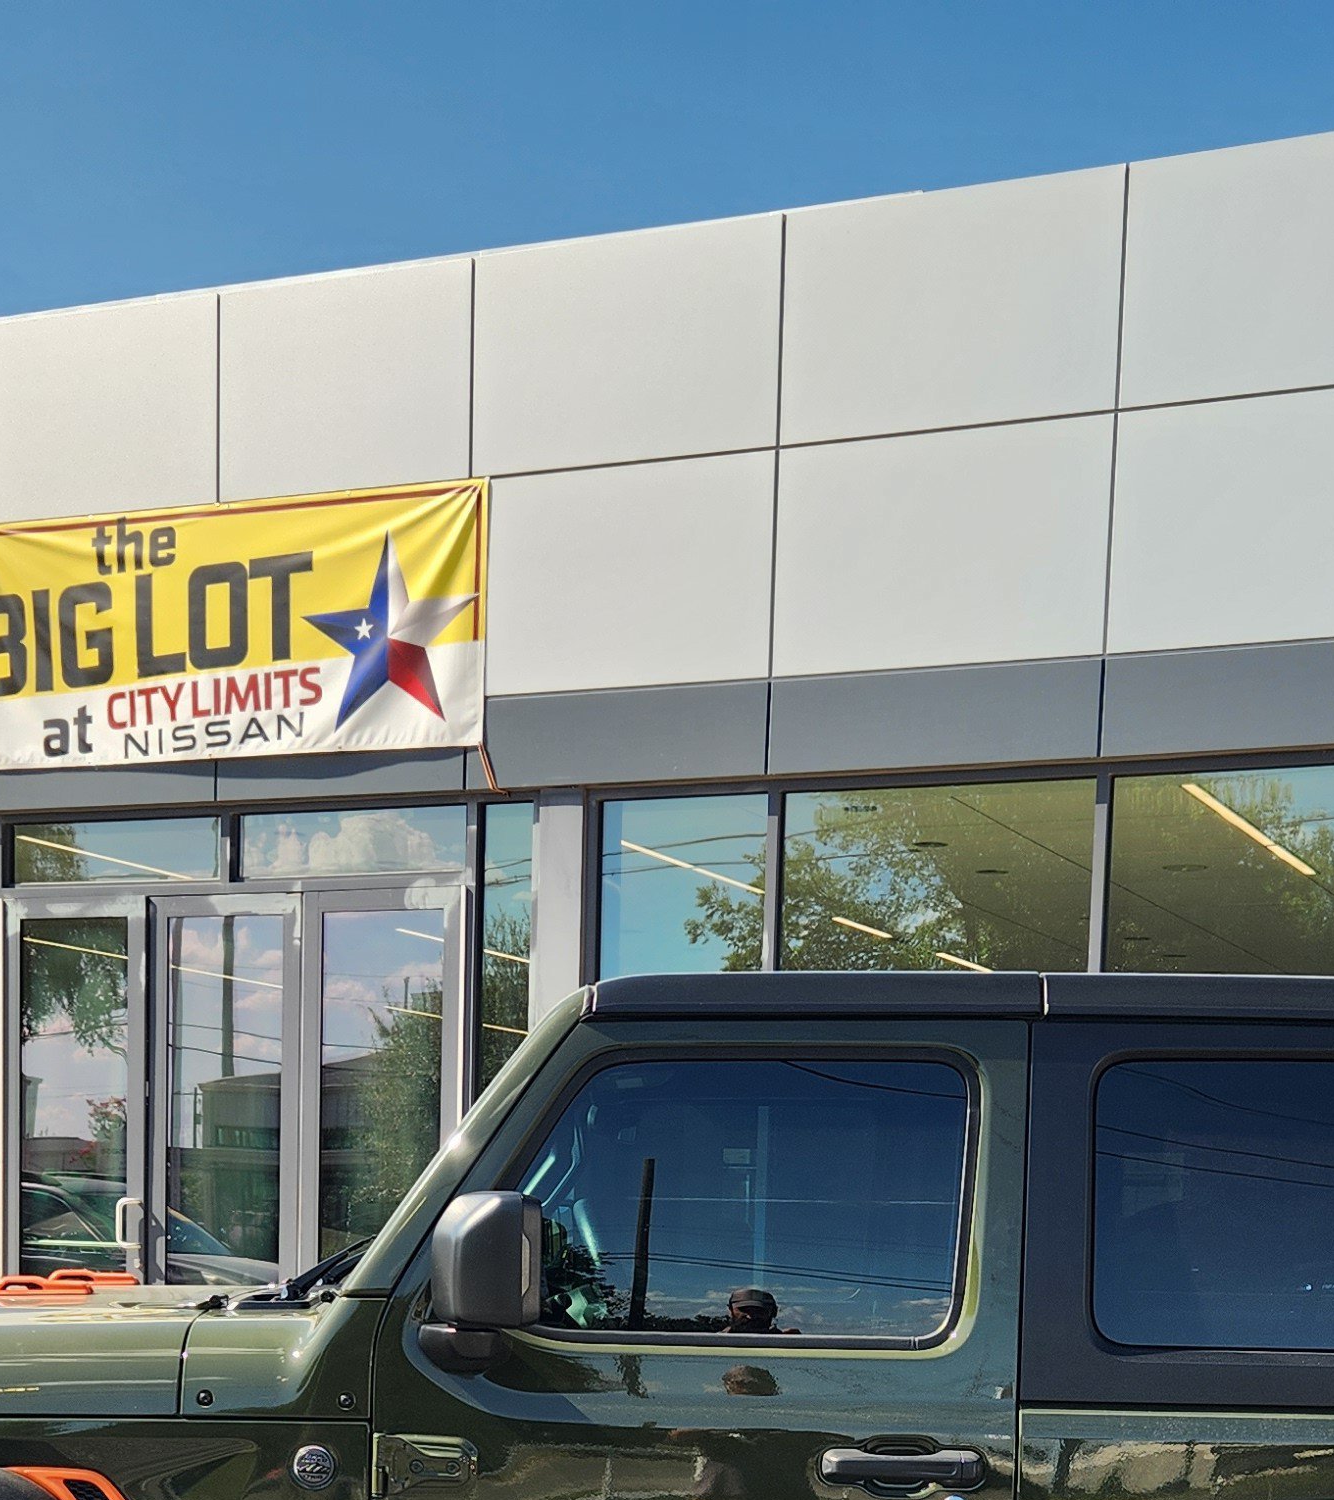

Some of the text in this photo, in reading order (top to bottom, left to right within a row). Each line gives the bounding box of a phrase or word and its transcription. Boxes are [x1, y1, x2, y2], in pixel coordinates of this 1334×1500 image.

[91, 517, 176, 576] the
[135, 550, 313, 678] LOT
[107, 666, 323, 731] CITY LIMITS
[43, 705, 93, 758] at
[123, 712, 306, 759] NISSAN
